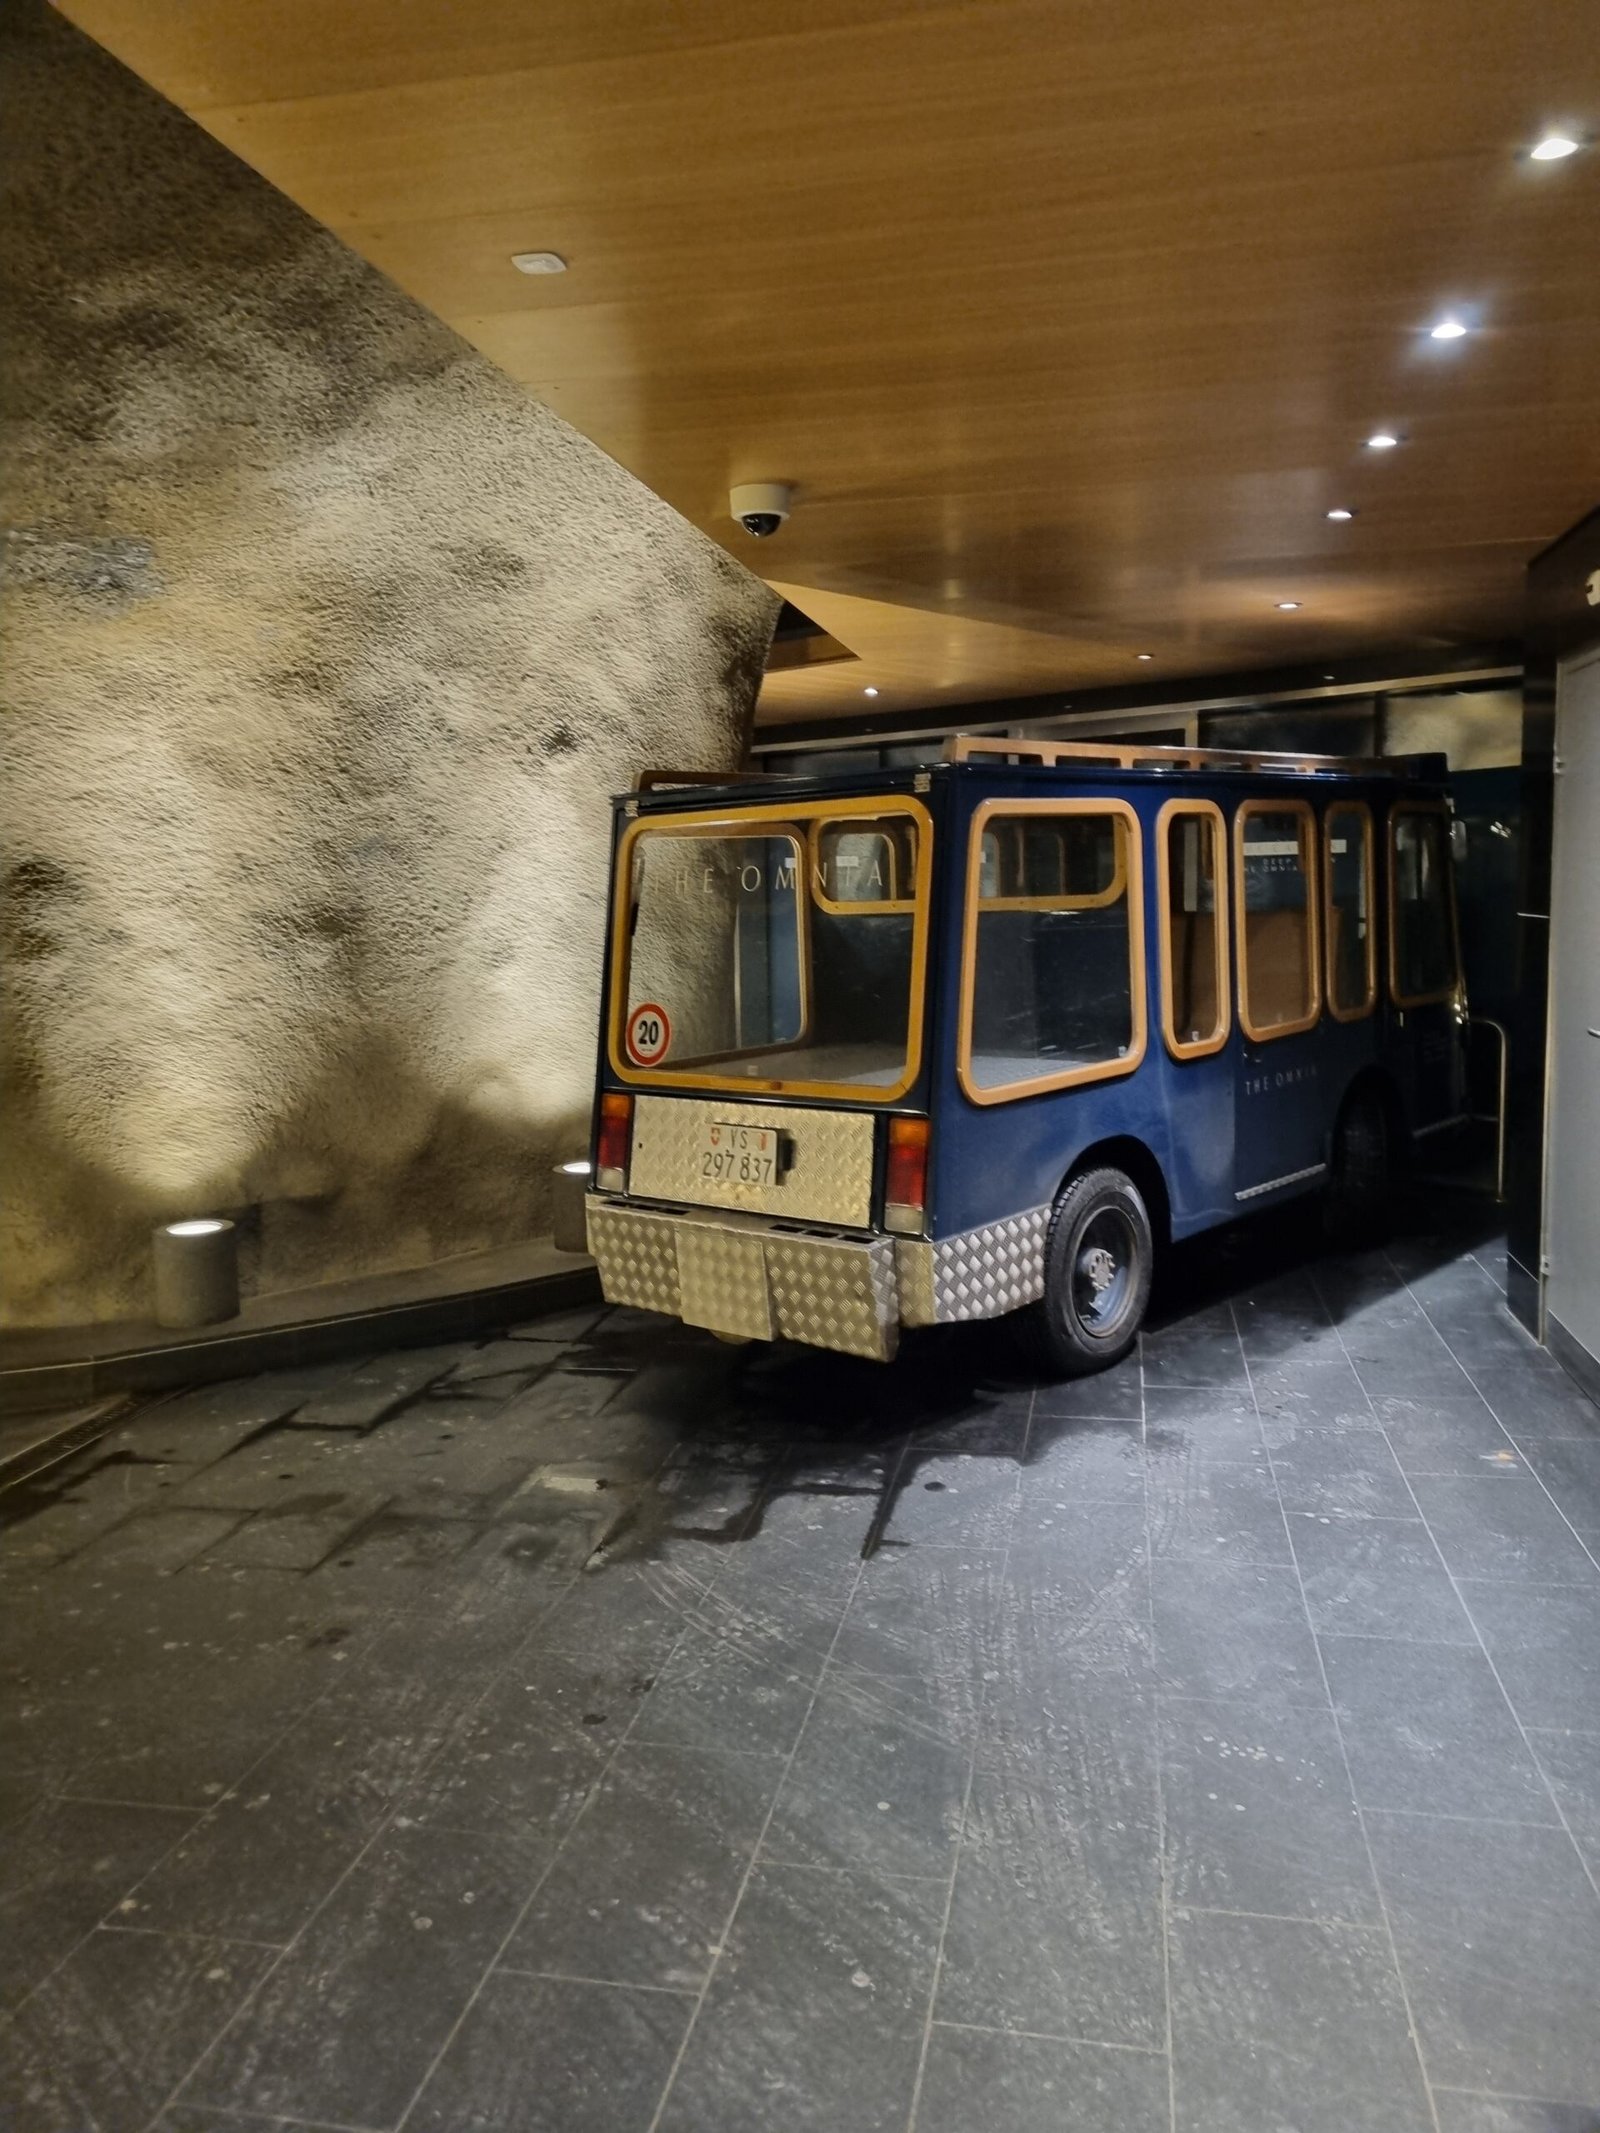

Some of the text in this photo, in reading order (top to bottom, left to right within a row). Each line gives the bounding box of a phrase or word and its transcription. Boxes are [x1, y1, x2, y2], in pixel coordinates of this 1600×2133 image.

[740, 860, 883, 893] OMNIA
[638, 1020, 659, 1046] 20
[1246, 1076, 1269, 1096] THE
[730, 1128, 748, 1150] VS
[703, 1151, 772, 1184] 297 837
